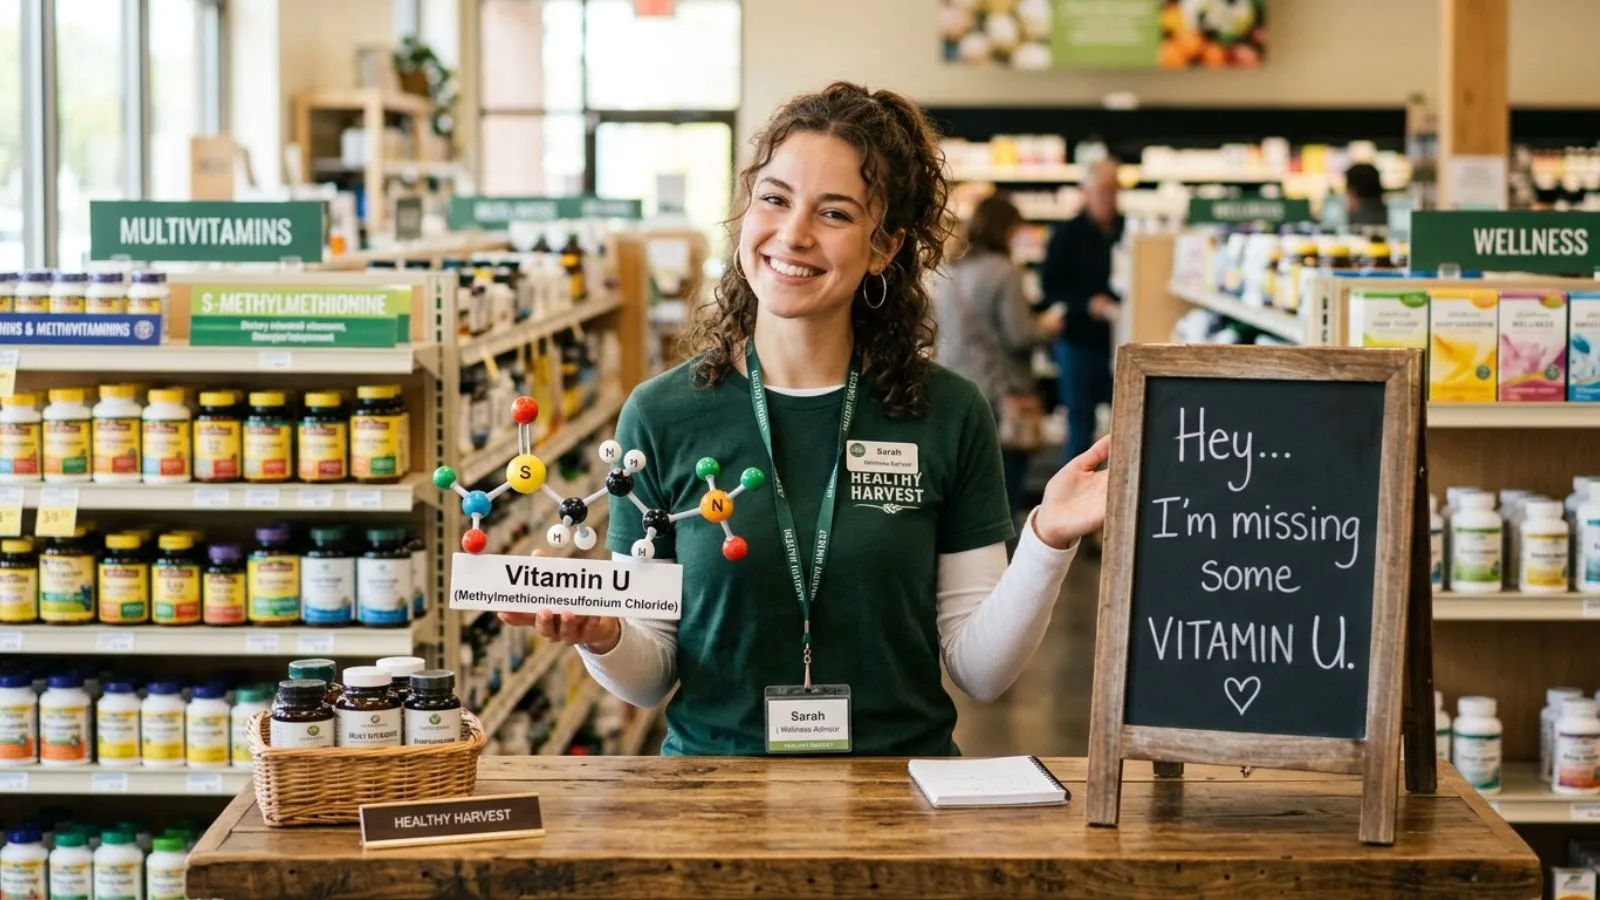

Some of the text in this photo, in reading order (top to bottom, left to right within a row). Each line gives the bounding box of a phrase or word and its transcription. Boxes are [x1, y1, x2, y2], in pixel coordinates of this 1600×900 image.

[120, 217, 293, 247] MULTIVITAMINS
[1473, 228, 1588, 256] WELLNESS
[202, 292, 387, 316] S-METHYLMETHIONINE
[877, 448, 902, 456] Sarah
[1173, 407, 1292, 492] Hey...
[519, 464, 533, 480] S
[711, 499, 724, 513] N
[851, 485, 924, 503] HARVEST
[1152, 496, 1360, 569] I'm missing
[505, 564, 631, 592] Vitamin U
[454, 589, 678, 613] (Methylmethioninesulfonium Chloride)
[1148, 615, 1354, 669] VITAMIN U.
[791, 711, 826, 722] Sarah
[394, 808, 511, 828] HEALTHY HARVEST
